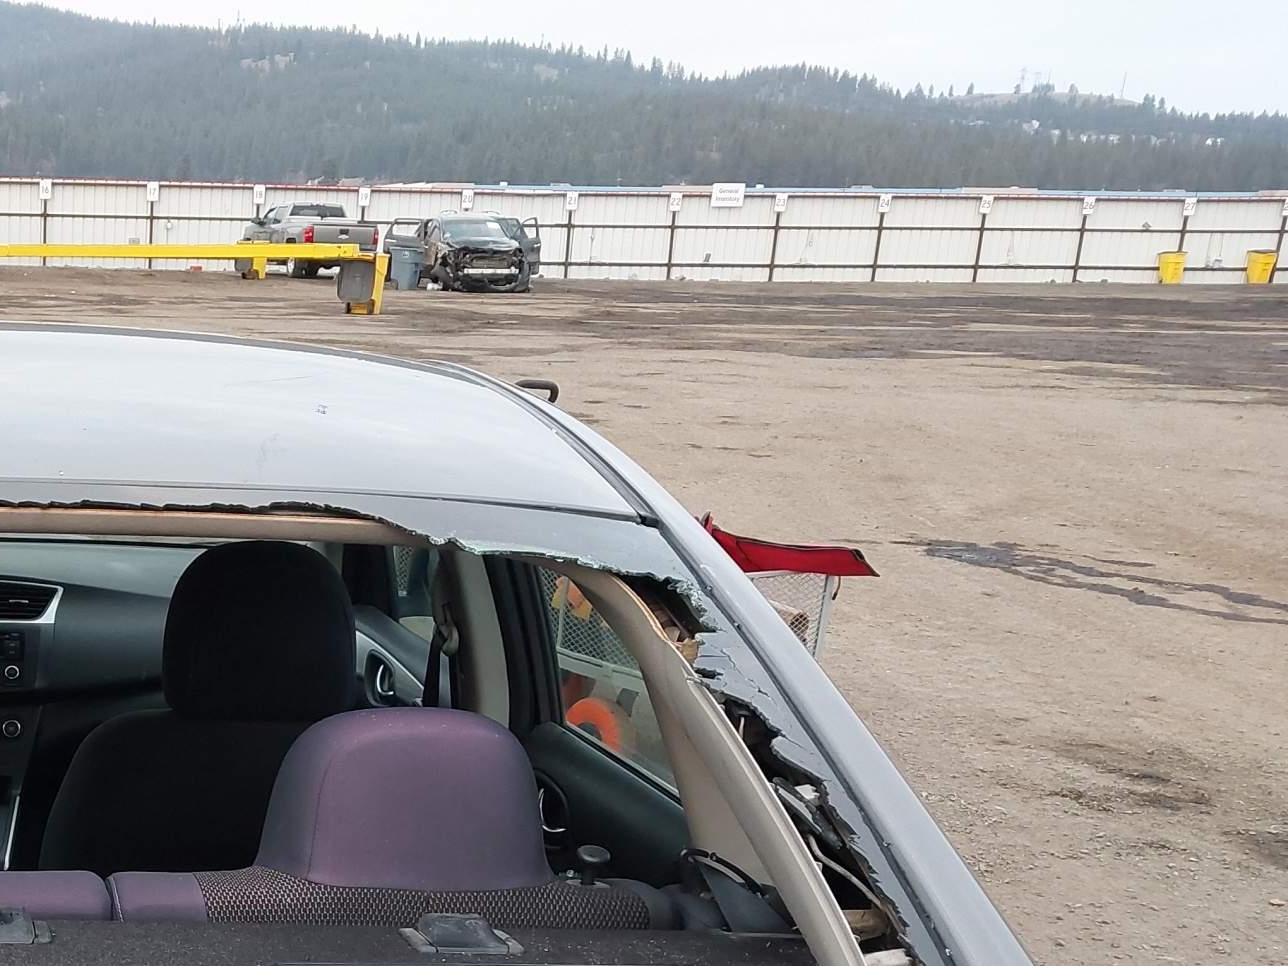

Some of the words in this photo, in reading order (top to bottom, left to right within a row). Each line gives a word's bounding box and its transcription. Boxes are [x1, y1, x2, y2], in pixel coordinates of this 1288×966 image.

[41, 185, 50, 194] 16
[462, 194, 472, 203] 20
[567, 196, 577, 205] 21
[670, 197, 681, 206] 22
[775, 198, 785, 207] 23
[879, 198, 889, 208] 24
[981, 199, 991, 209] 25
[1083, 201, 1094, 210] 26
[1184, 201, 1194, 211] 27
